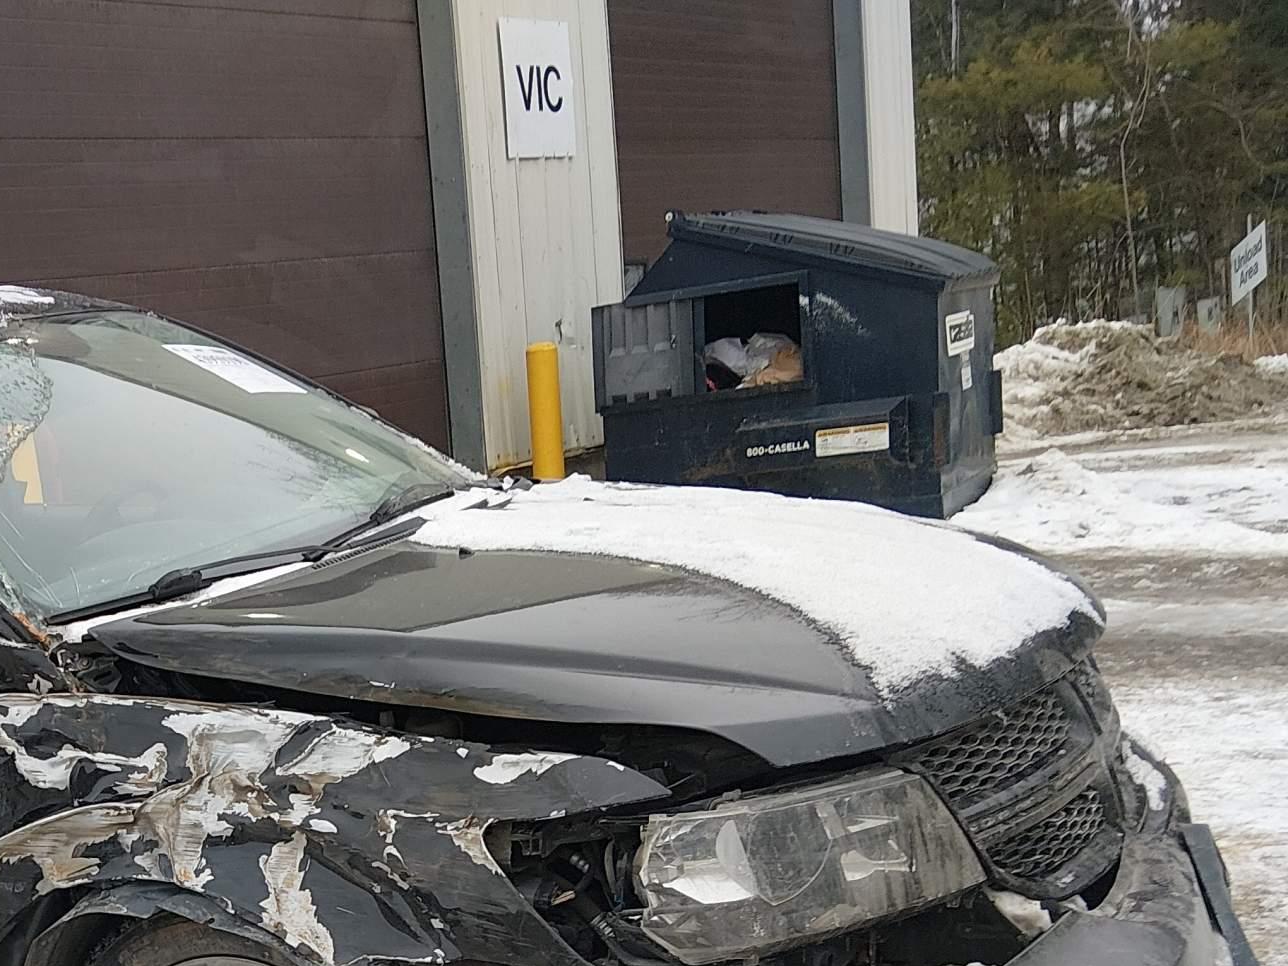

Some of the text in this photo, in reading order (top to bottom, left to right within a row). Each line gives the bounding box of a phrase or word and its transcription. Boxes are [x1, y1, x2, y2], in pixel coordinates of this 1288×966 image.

[515, 64, 563, 113] VIC
[1233, 234, 1263, 274] Unload
[1239, 261, 1259, 288] Area
